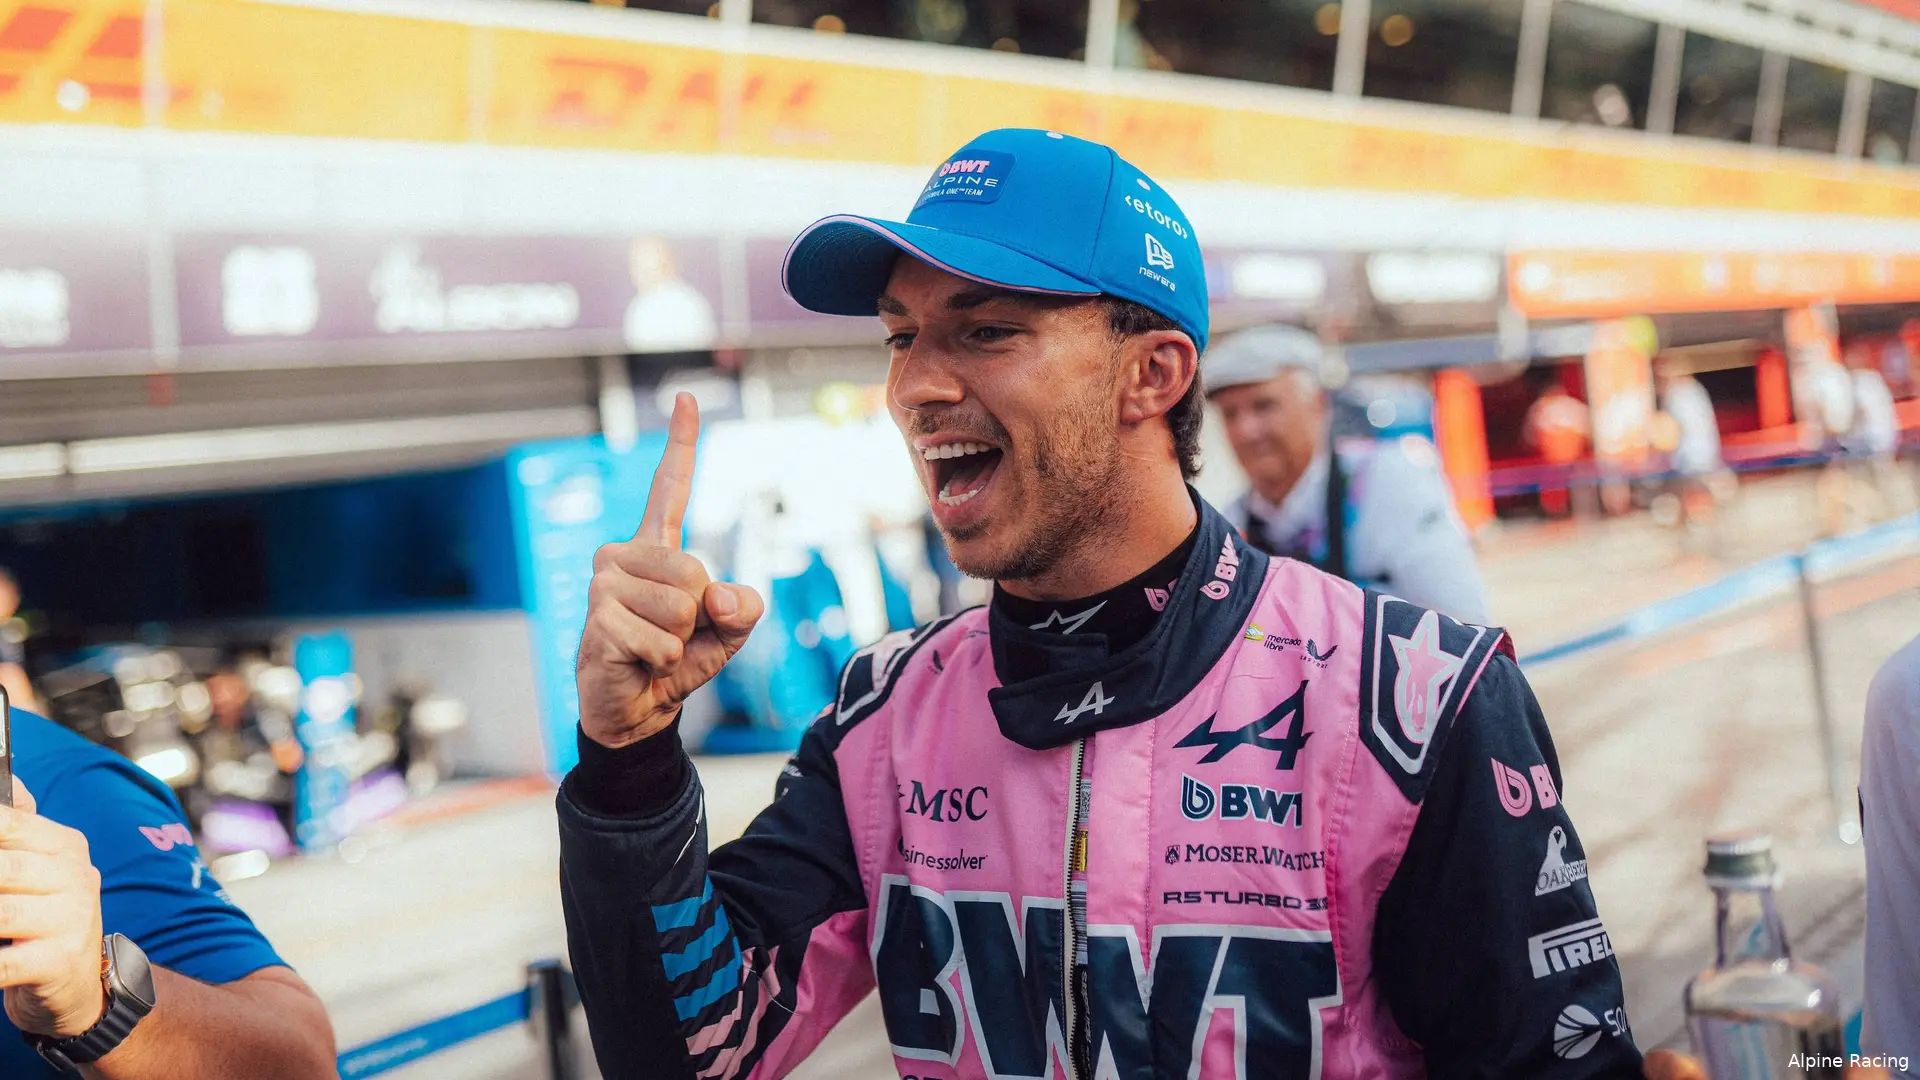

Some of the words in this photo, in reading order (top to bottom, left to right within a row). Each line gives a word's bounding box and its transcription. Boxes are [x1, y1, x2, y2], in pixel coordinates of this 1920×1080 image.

[949, 160, 990, 174] BWT
[1214, 533, 1239, 582] BW
[1263, 640, 1284, 651] libre
[1267, 634, 1302, 646] mercado
[905, 780, 988, 822] MSC
[871, 873, 1343, 1080] BWT
